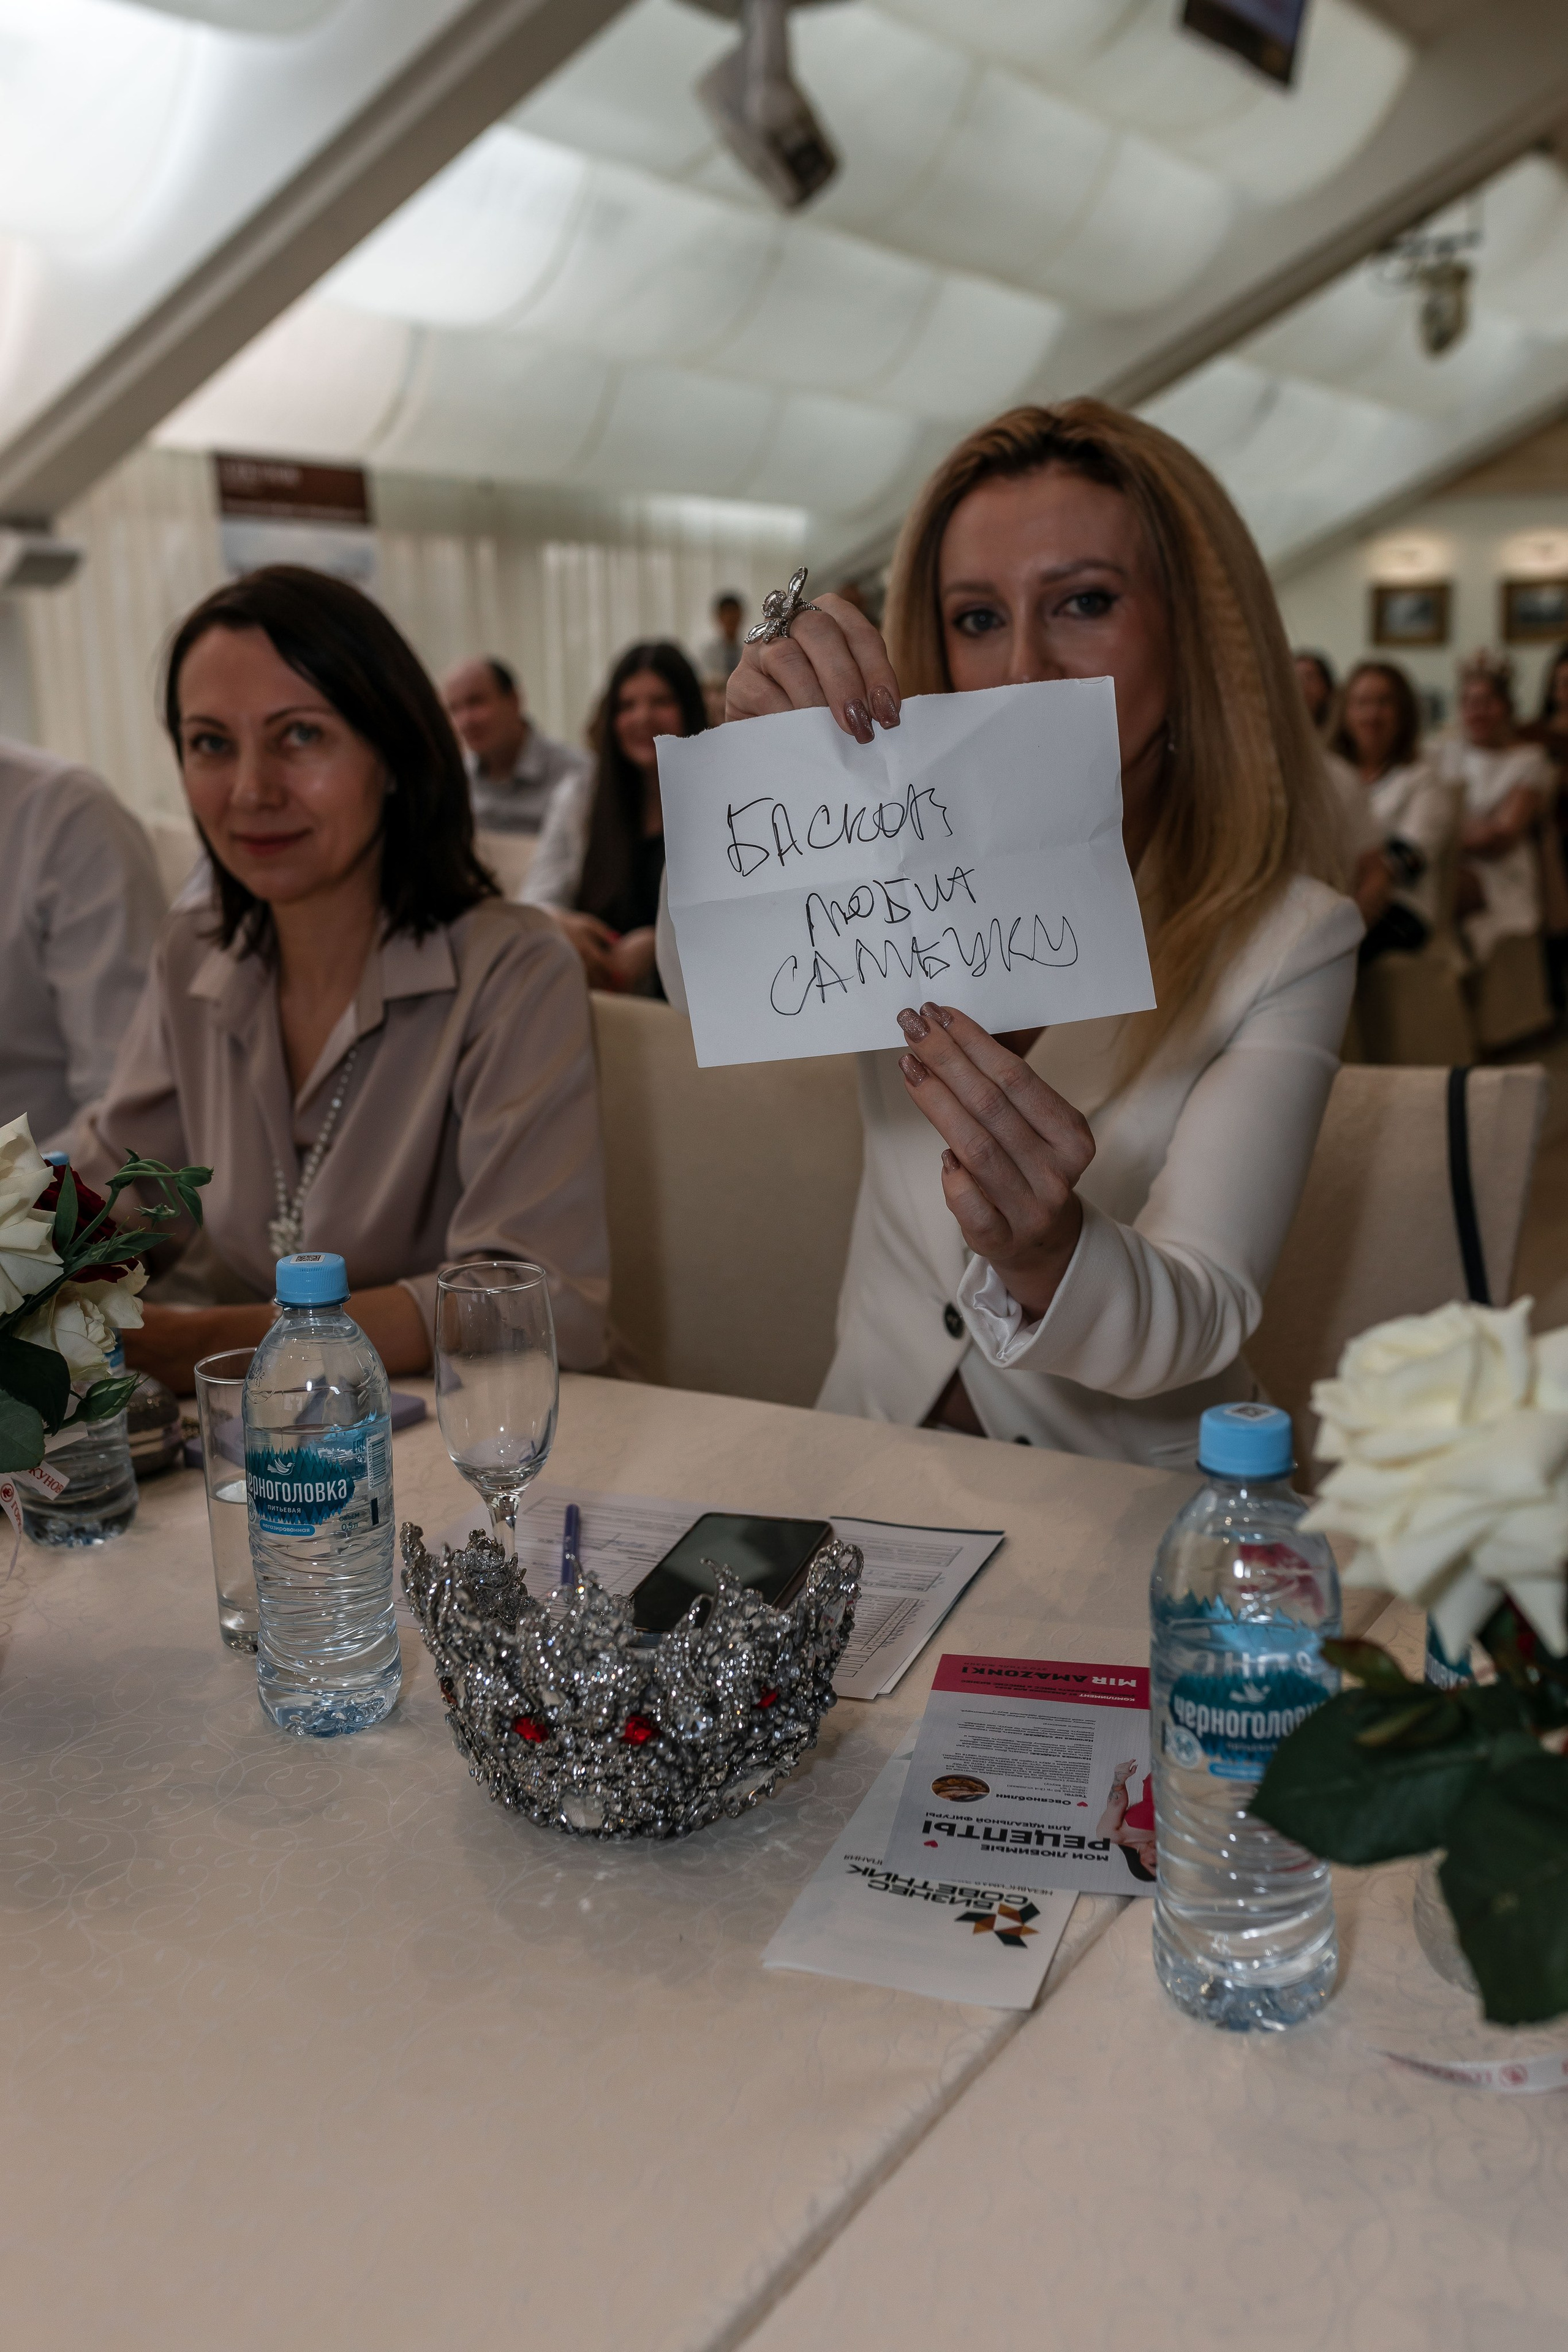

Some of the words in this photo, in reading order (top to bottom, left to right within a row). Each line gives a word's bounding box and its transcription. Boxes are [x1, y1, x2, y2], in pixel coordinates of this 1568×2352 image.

[268, 1504, 301, 1513] ПИТЬЕВАЯ
[262, 1523, 310, 1533] негазированная
[962, 1667, 1088, 1682] AMAZONKI
[1091, 1676, 1136, 1687] MIR
[1078, 1693, 1135, 1702] КОМПЛИМЕНТ
[1174, 1694, 1324, 1740] черноголов
[995, 1793, 1071, 1805] Овсяноблин
[924, 1812, 973, 1821] ФИГУРЫ
[975, 1817, 1044, 1828] ИДЕАЛЬНОЙ
[921, 1819, 1110, 1852] РЕЦЕПТЫ
[979, 1844, 1068, 1860] ЛЮБИМЫЕ
[1071, 1852, 1109, 1863] МОИ
[843, 1854, 883, 1866] ПАНИЯ
[845, 1864, 1028, 1905] СОВЕТНИК
[867, 1879, 993, 1910] БИЗНЕС
